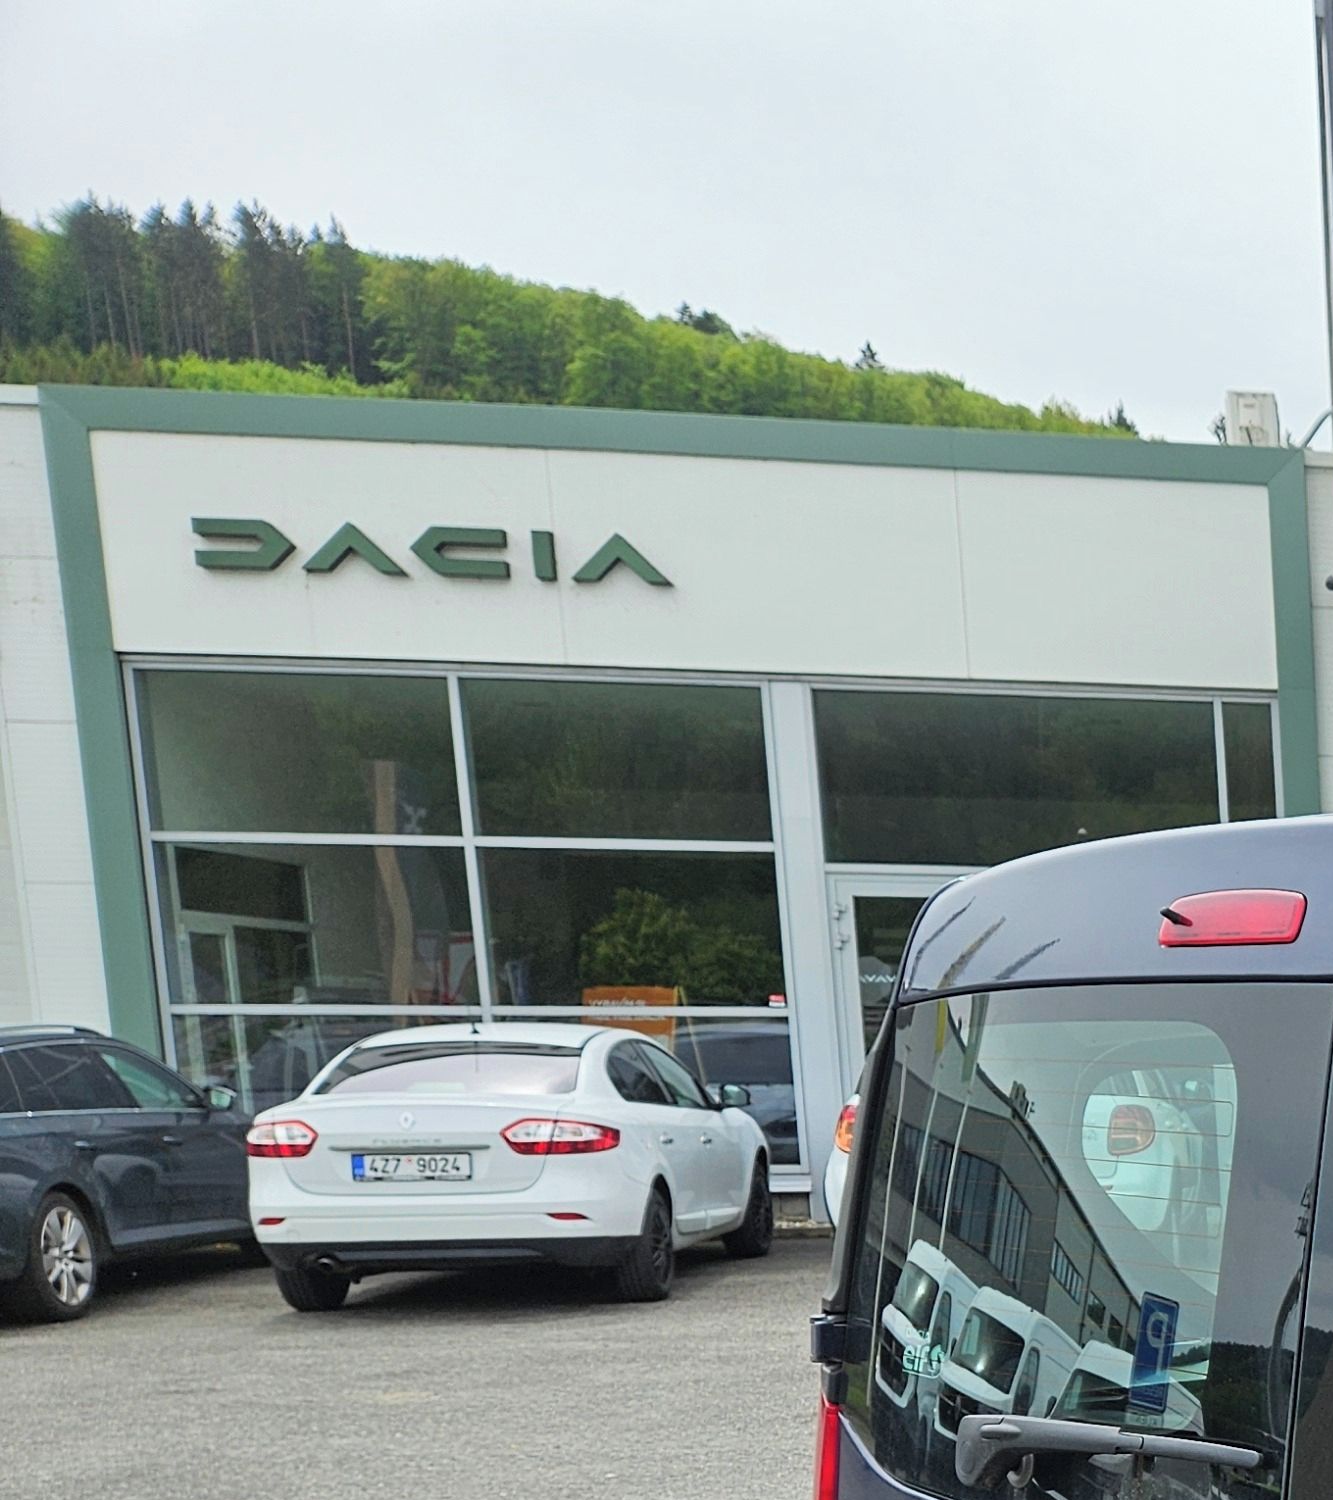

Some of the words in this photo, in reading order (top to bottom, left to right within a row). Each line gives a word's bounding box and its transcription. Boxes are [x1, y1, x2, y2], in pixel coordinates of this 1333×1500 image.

[190, 516, 675, 588] DACIA
[369, 1157, 401, 1174] 4Z7
[416, 1157, 460, 1173] 9024
